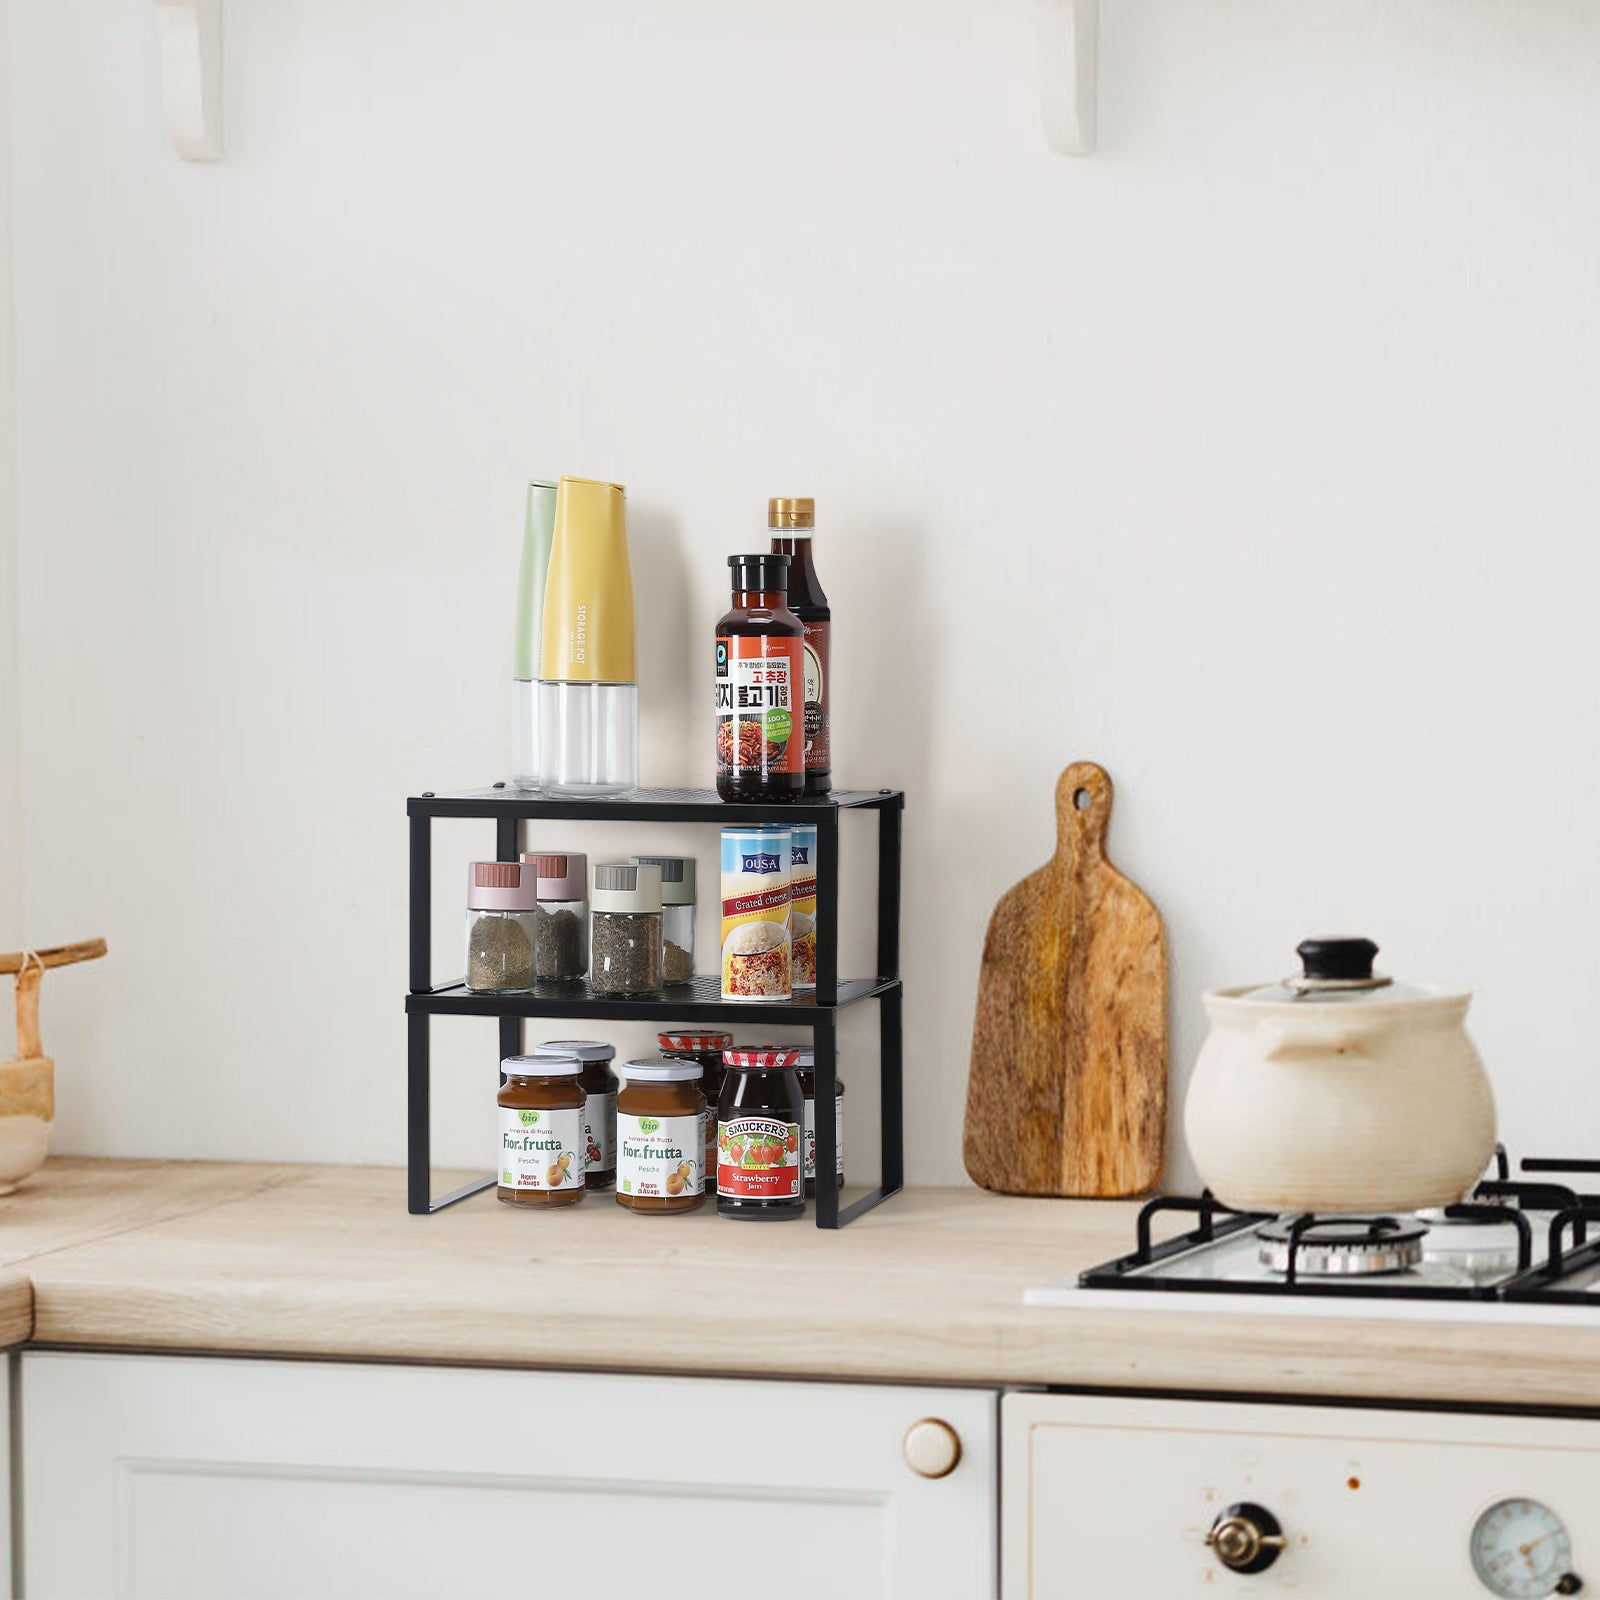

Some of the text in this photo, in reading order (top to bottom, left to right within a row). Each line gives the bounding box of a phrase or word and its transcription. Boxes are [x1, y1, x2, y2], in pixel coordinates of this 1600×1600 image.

[576, 605, 586, 664] STORAGE POT
[752, 671, 787, 684] 고추장
[791, 851, 804, 861] SA
[745, 859, 777, 869] OUSA
[792, 884, 816, 896] cheese
[735, 892, 787, 910] Grated cheese
[521, 1112, 538, 1122] bio
[641, 1120, 658, 1131] bio
[728, 1122, 786, 1137] SMUCKER'S
[503, 1133, 520, 1150] Fior
[523, 1136, 562, 1151] frutta
[623, 1141, 640, 1158] Fior
[643, 1144, 682, 1159] frutta
[518, 1157, 540, 1165] Pesche
[638, 1165, 660, 1173] Pesche
[731, 1172, 780, 1185] Strawberry
